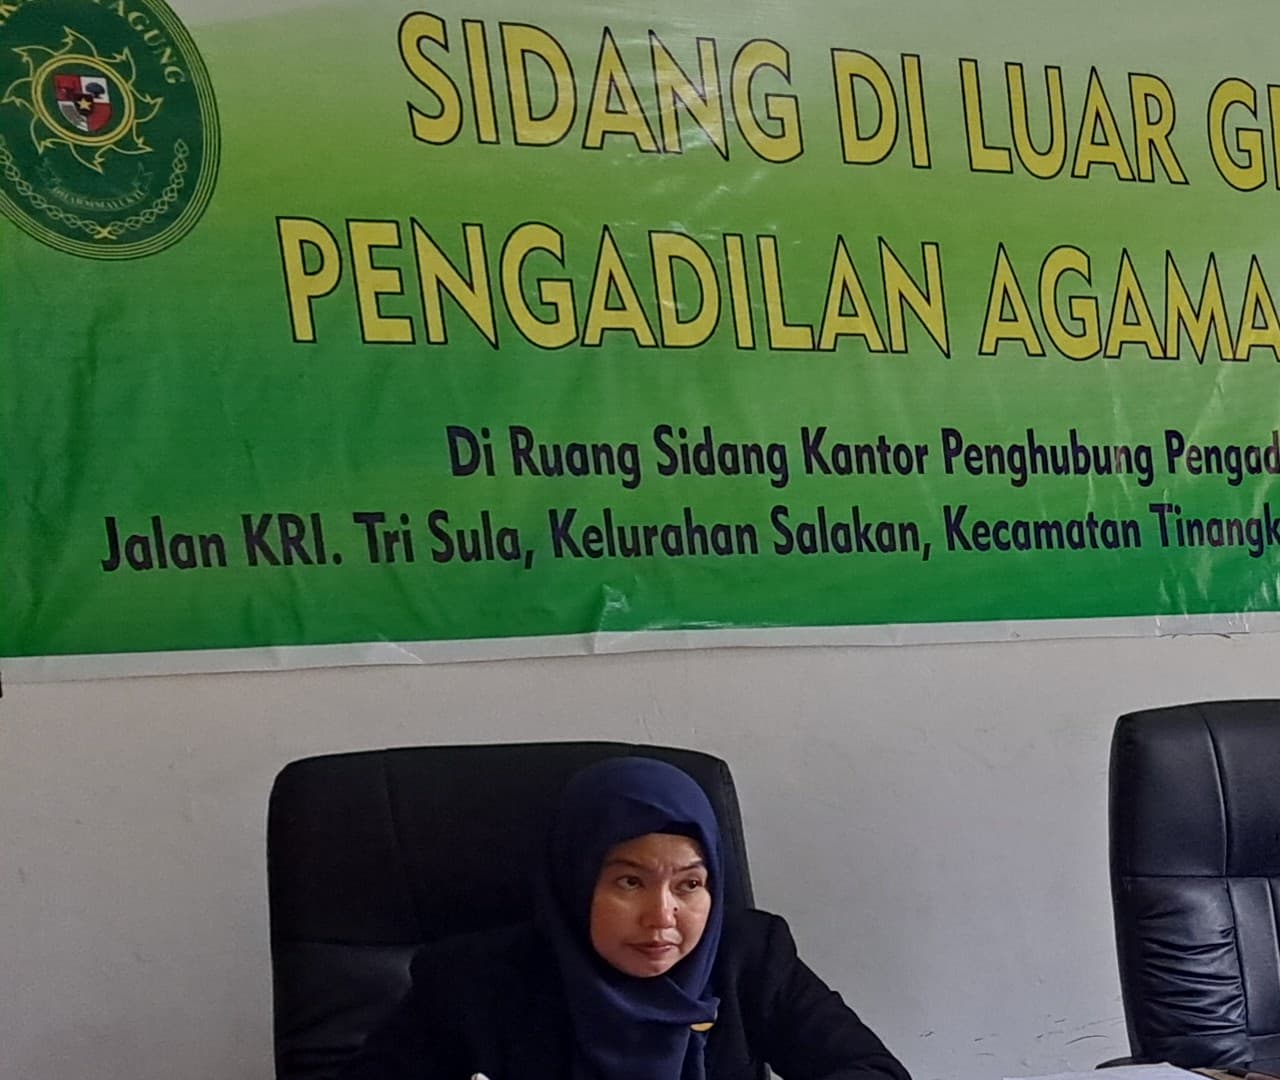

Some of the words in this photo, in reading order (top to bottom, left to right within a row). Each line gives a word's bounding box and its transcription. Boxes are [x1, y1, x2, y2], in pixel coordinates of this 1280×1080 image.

[398, 10, 803, 163] SIDANG
[830, 47, 932, 169] DI
[958, 57, 1190, 186] LUAR
[275, 216, 951, 359] PENGADILAN
[445, 425, 497, 477] Di
[508, 425, 642, 490] Ruang
[652, 423, 790, 489] Sidang
[799, 425, 929, 476] Kantor
[940, 427, 1155, 488] Penghubung
[100, 515, 228, 573] Jalan
[240, 512, 343, 568] KRI.
[352, 510, 416, 565] Tri
[427, 509, 536, 571] Sula,
[548, 507, 759, 560] Kelurahan
[769, 504, 933, 562] Salakan,
[942, 503, 1143, 554] Kecamatan
